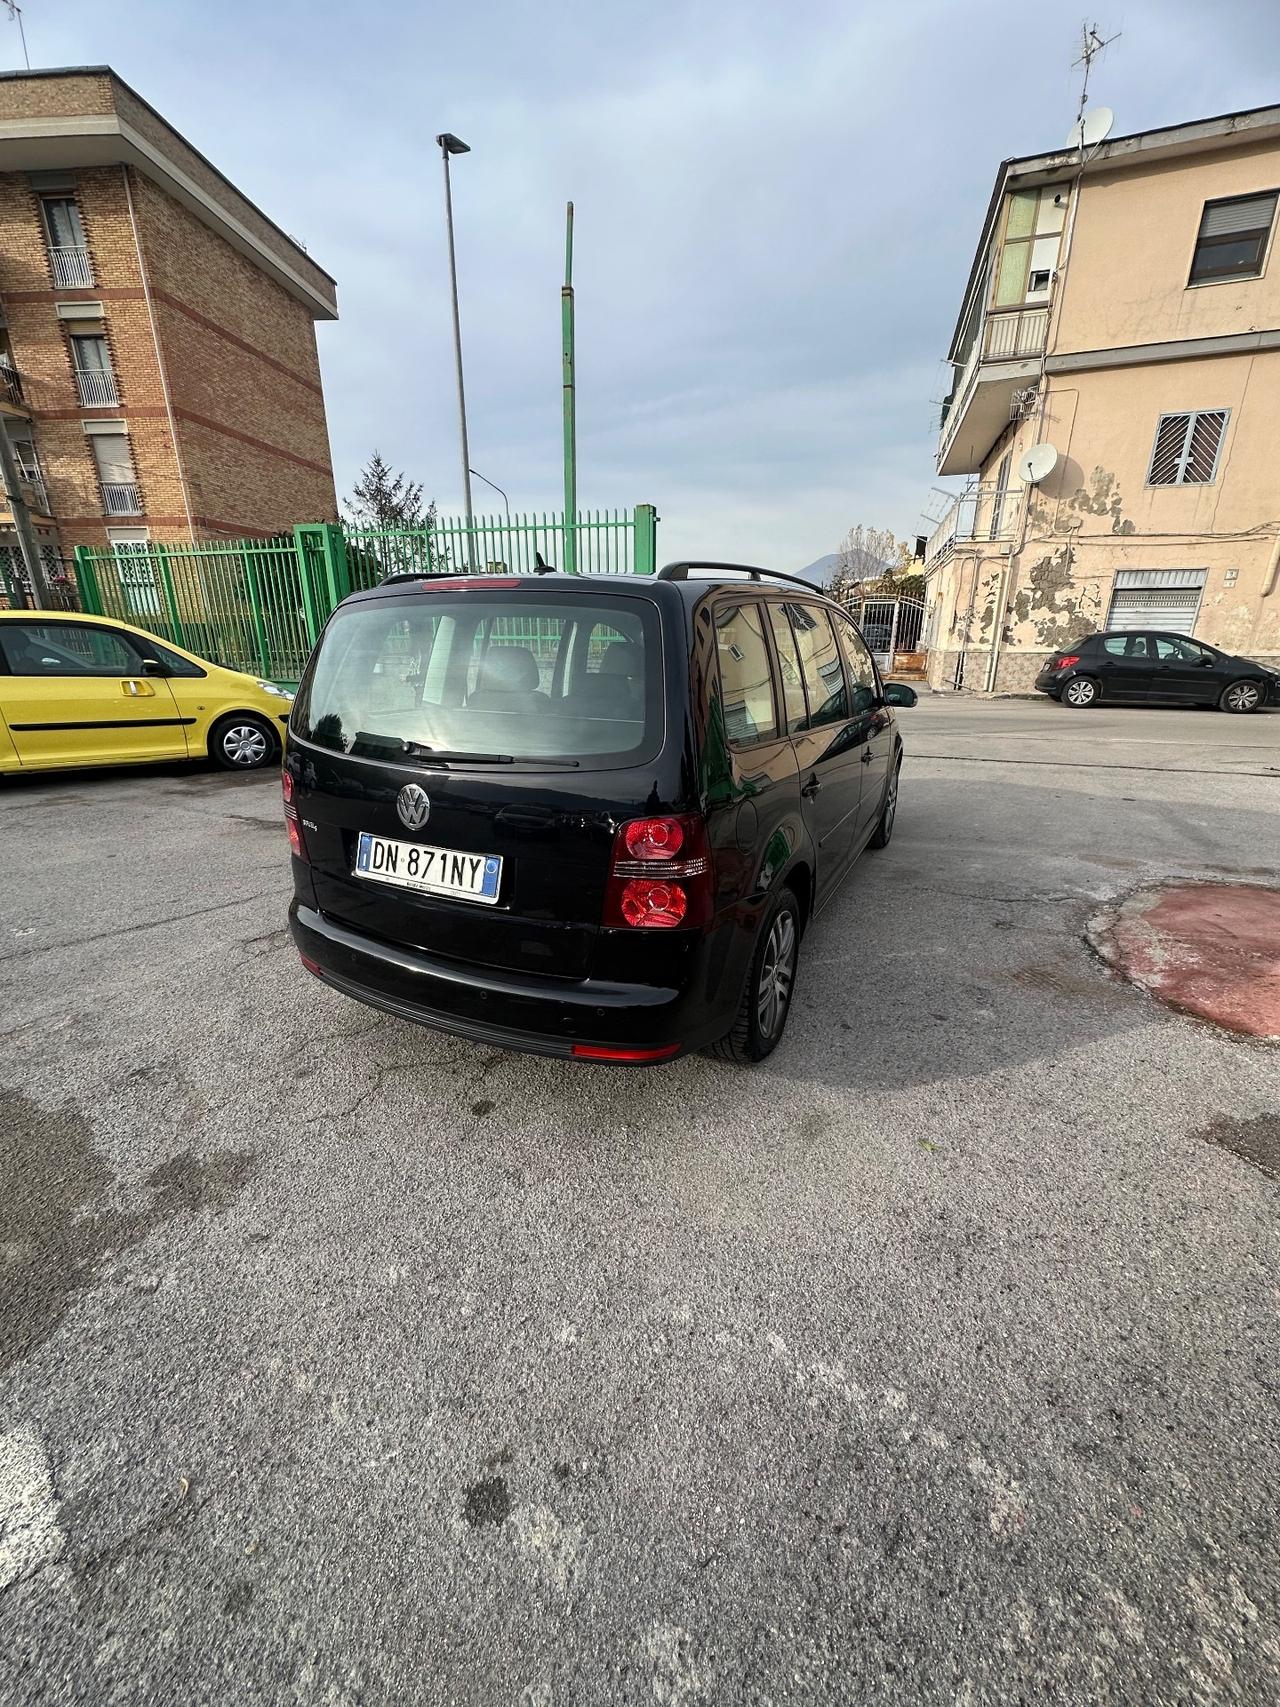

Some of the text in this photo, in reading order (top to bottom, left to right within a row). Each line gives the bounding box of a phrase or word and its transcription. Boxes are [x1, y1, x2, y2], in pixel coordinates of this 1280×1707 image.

[398, 784, 430, 831] VW
[372, 841, 482, 889] DN 871NY
